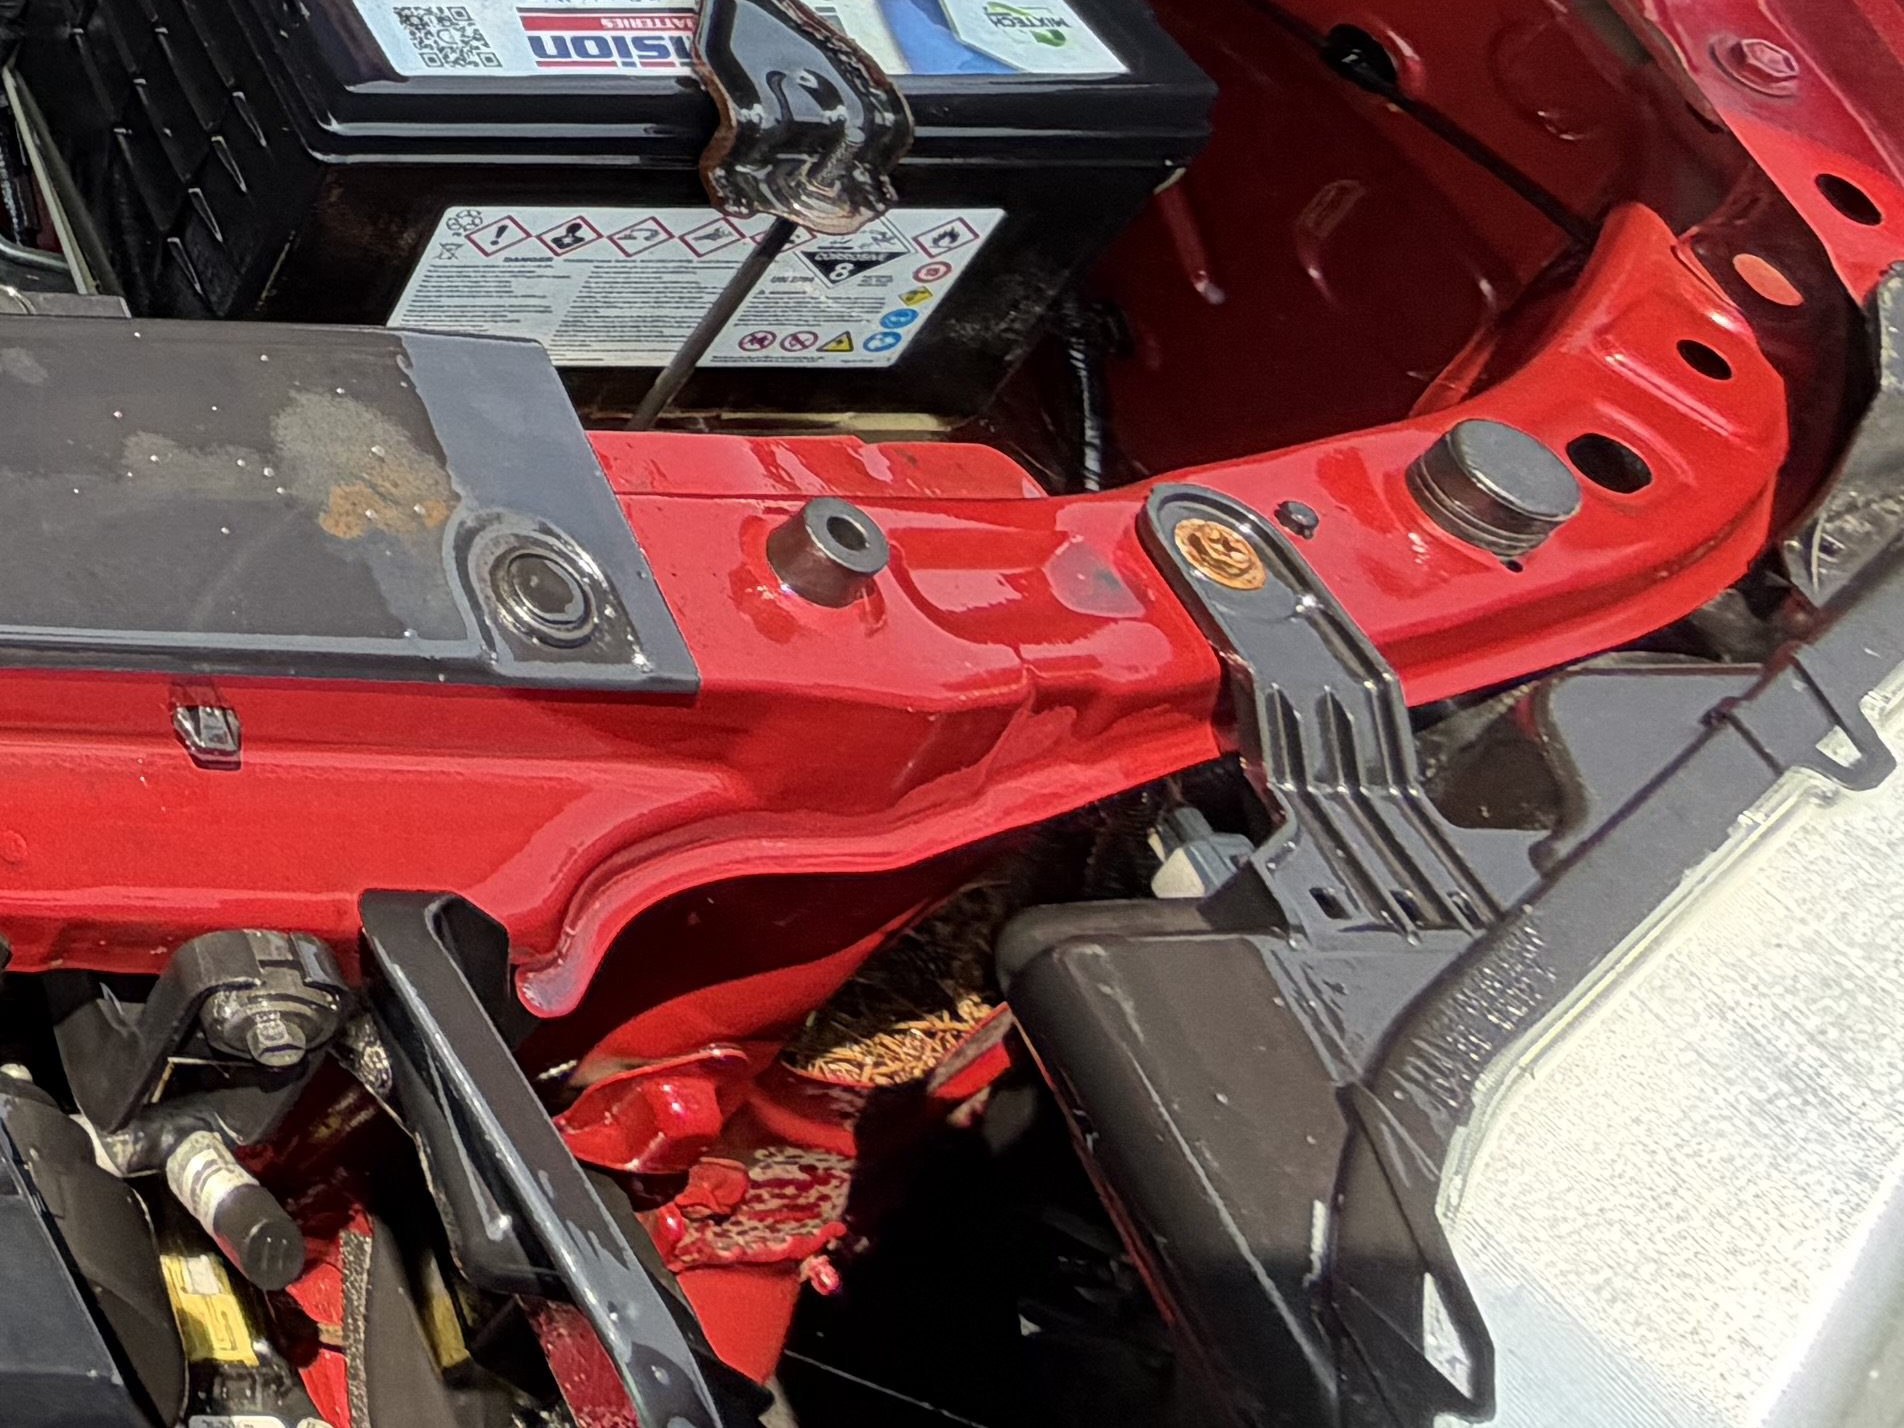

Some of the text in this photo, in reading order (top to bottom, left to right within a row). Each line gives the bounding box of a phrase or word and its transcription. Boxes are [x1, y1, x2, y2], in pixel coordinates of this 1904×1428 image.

[988, 13, 1071, 29] MIXTECH
[528, 35, 693, 69] ision
[828, 262, 855, 281] 8
